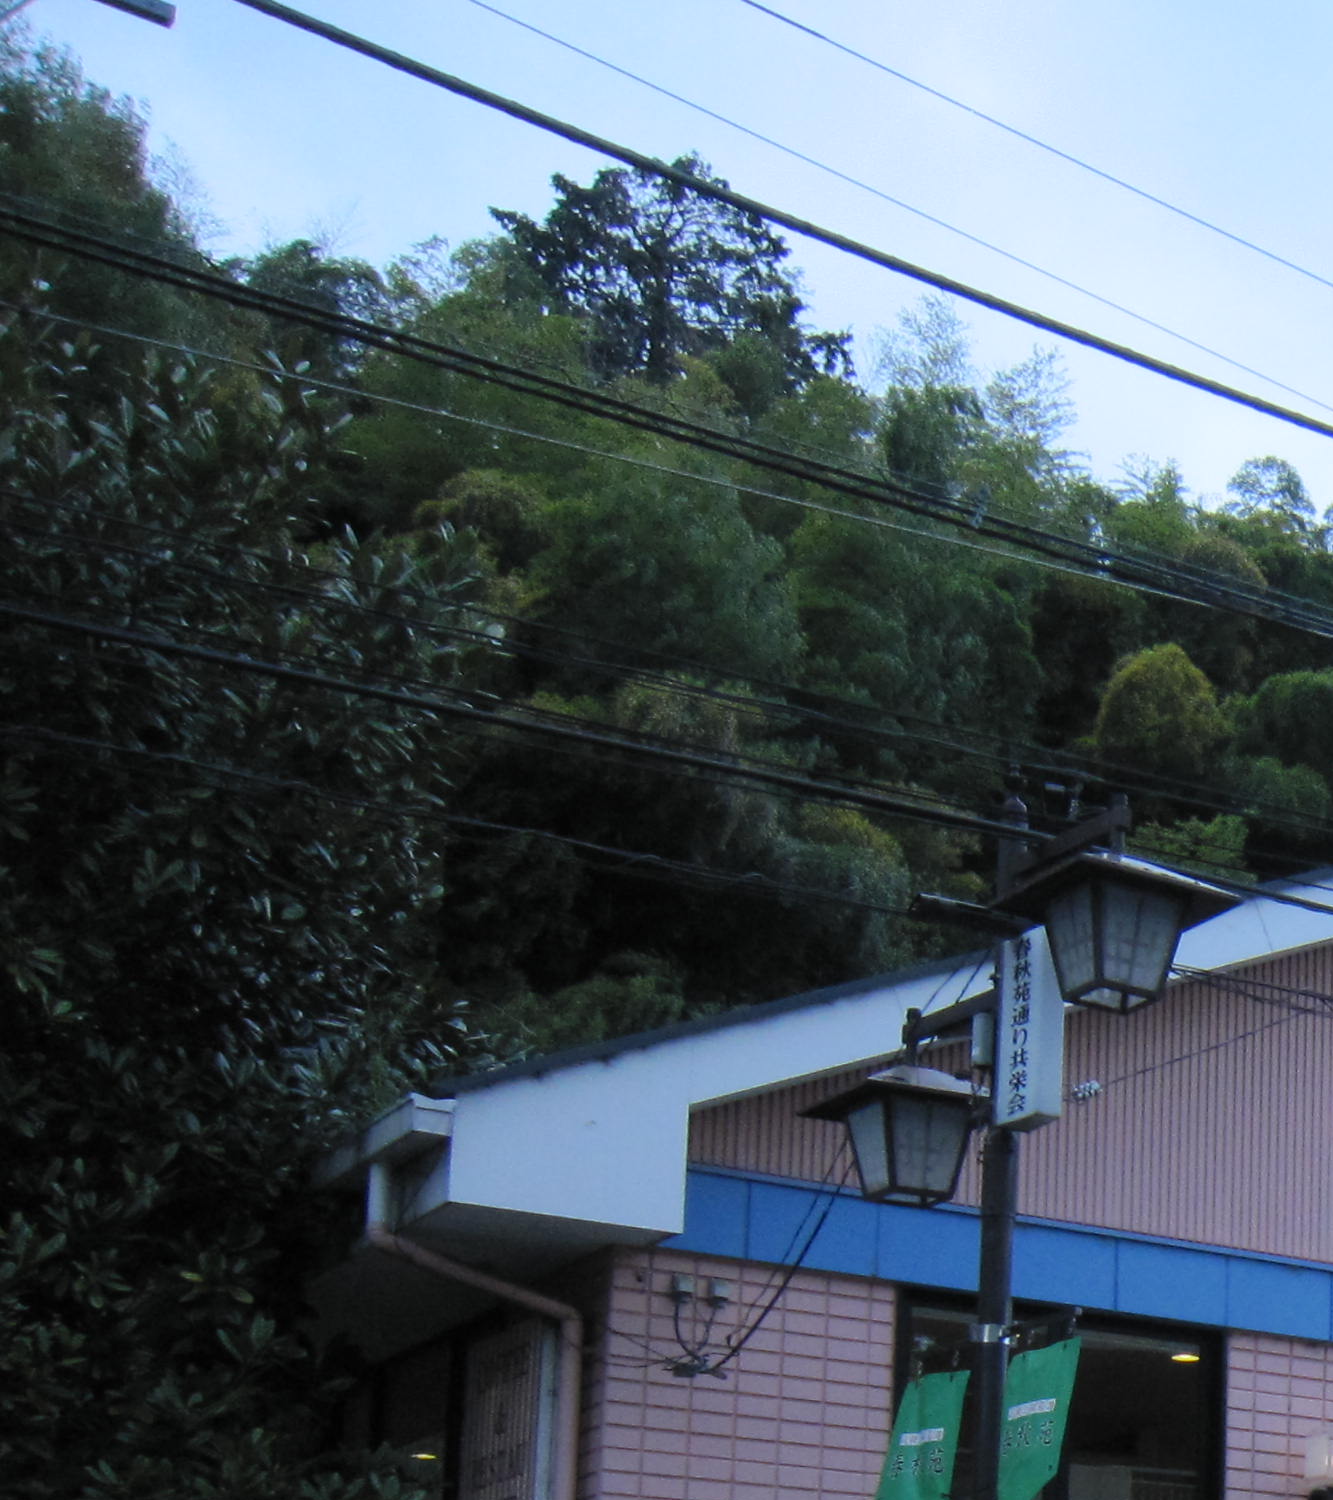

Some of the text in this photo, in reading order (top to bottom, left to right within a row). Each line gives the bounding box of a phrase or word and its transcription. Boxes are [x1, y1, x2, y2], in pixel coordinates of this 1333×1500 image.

[1007, 937, 1032, 1116] 春秋苑通り共栄会
